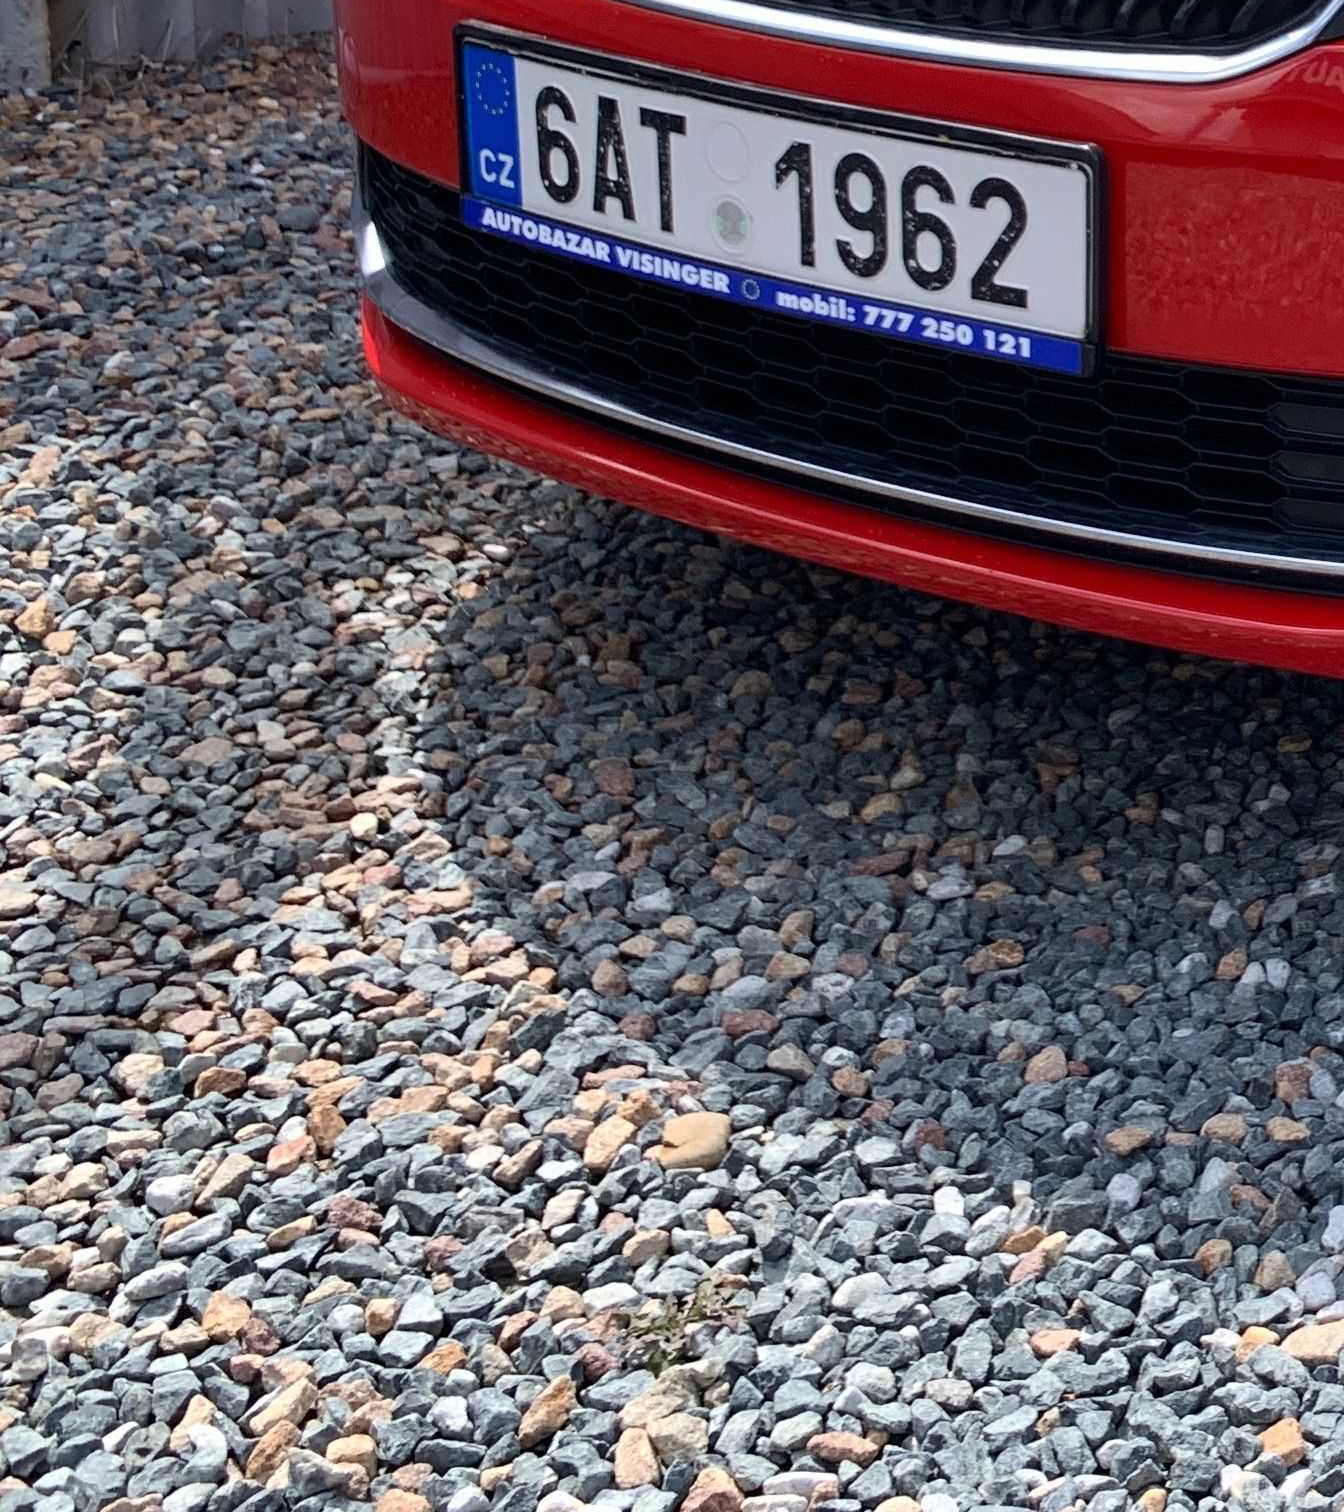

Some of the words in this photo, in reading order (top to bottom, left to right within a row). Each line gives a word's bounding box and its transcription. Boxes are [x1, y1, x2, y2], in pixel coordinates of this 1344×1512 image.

[478, 147, 516, 189] CZ
[534, 86, 687, 234] 6AT
[774, 140, 1029, 308] 1962
[482, 207, 611, 263] AUTOBAZAR
[616, 244, 731, 294] VISINGER
[775, 290, 855, 323] mobil:
[862, 305, 913, 333] 777
[920, 317, 974, 346] 250
[982, 331, 1032, 358] 121
